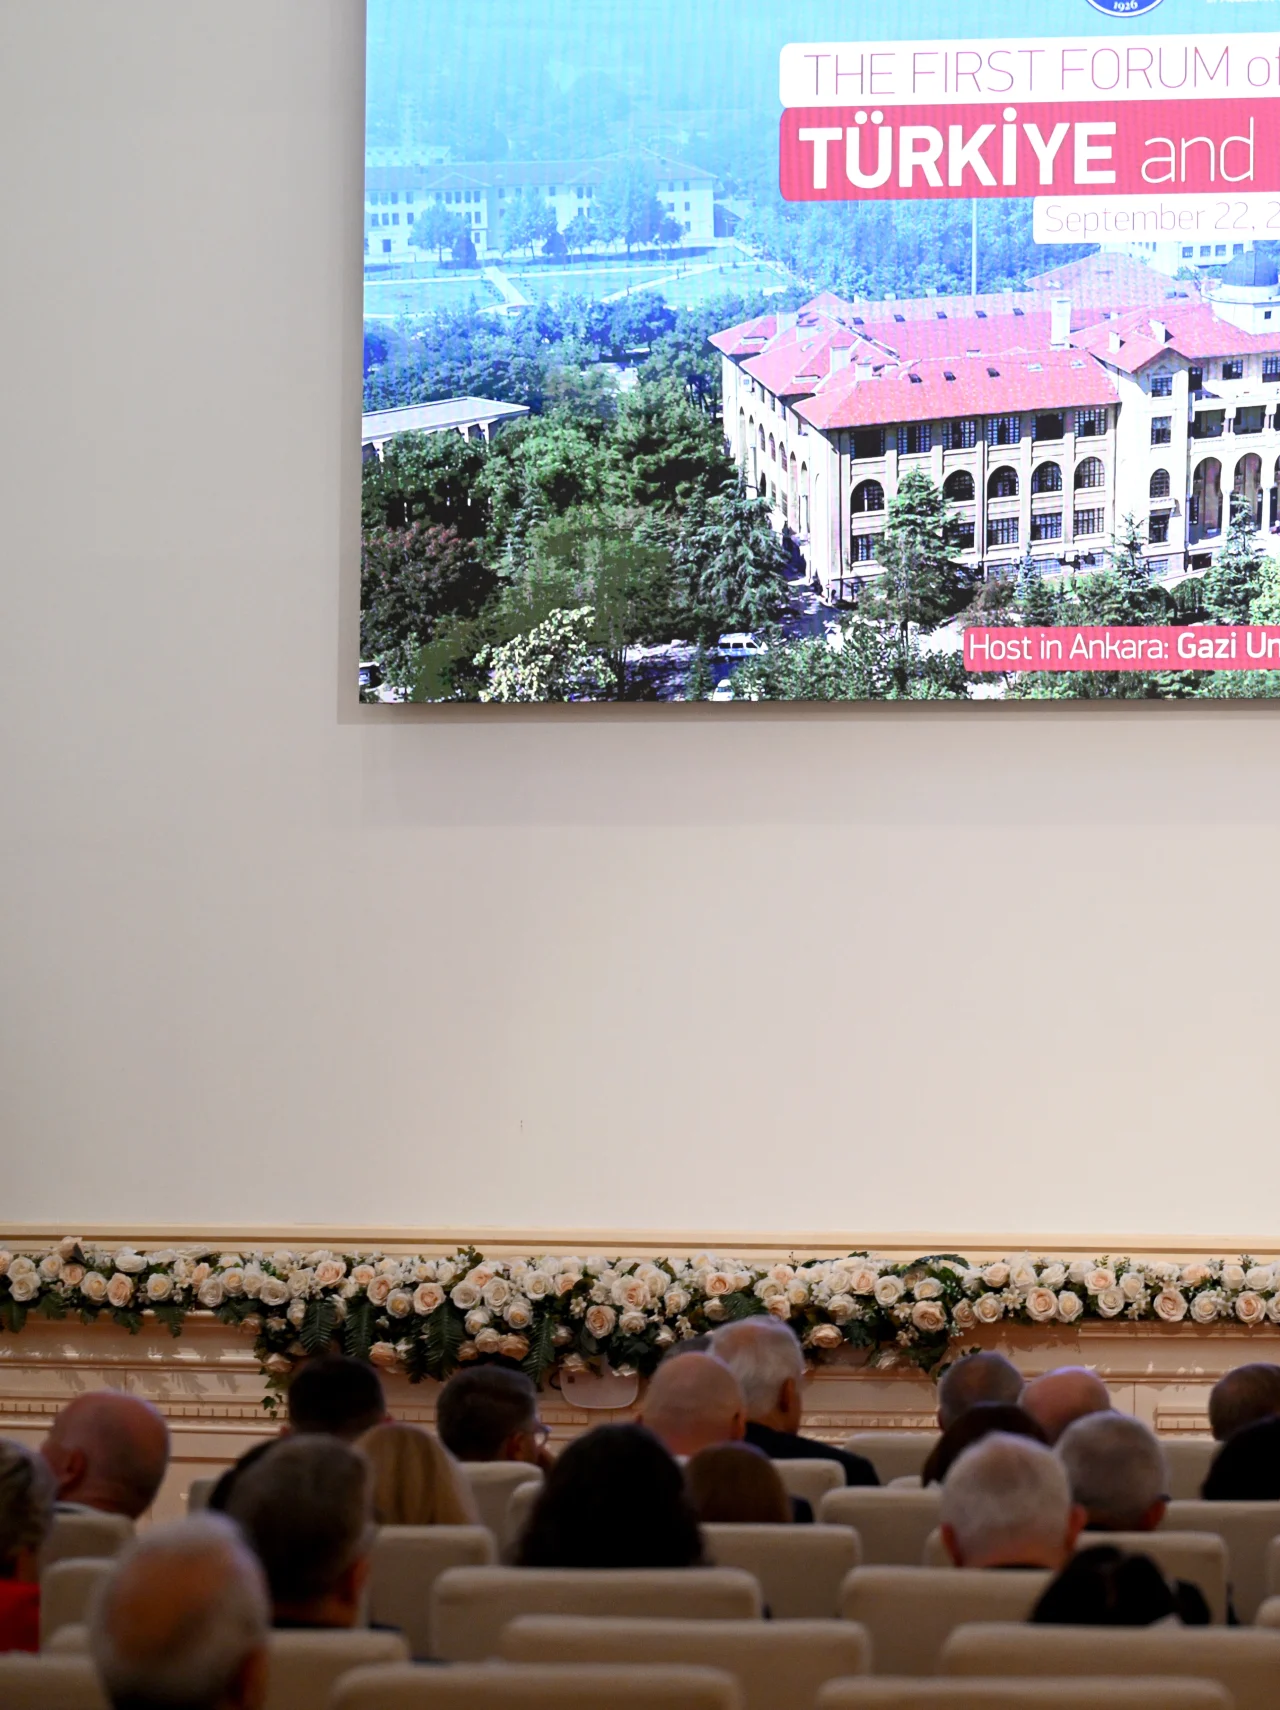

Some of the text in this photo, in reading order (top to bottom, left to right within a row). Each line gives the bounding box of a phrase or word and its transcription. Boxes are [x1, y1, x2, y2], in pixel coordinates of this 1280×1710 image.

[1113, 0, 1139, 12] 1926
[804, 53, 896, 96] THE
[912, 50, 1045, 94] FIRST
[1061, 46, 1229, 91] FORUM
[798, 107, 1117, 190] TÜRKİYE
[1141, 117, 1255, 184] and
[1045, 202, 1206, 239] September
[1214, 201, 1256, 231] 22,
[969, 633, 1032, 661] Host
[1039, 633, 1062, 660] in
[1069, 632, 1170, 660] Ankara:
[1177, 631, 1238, 659] Gazi
